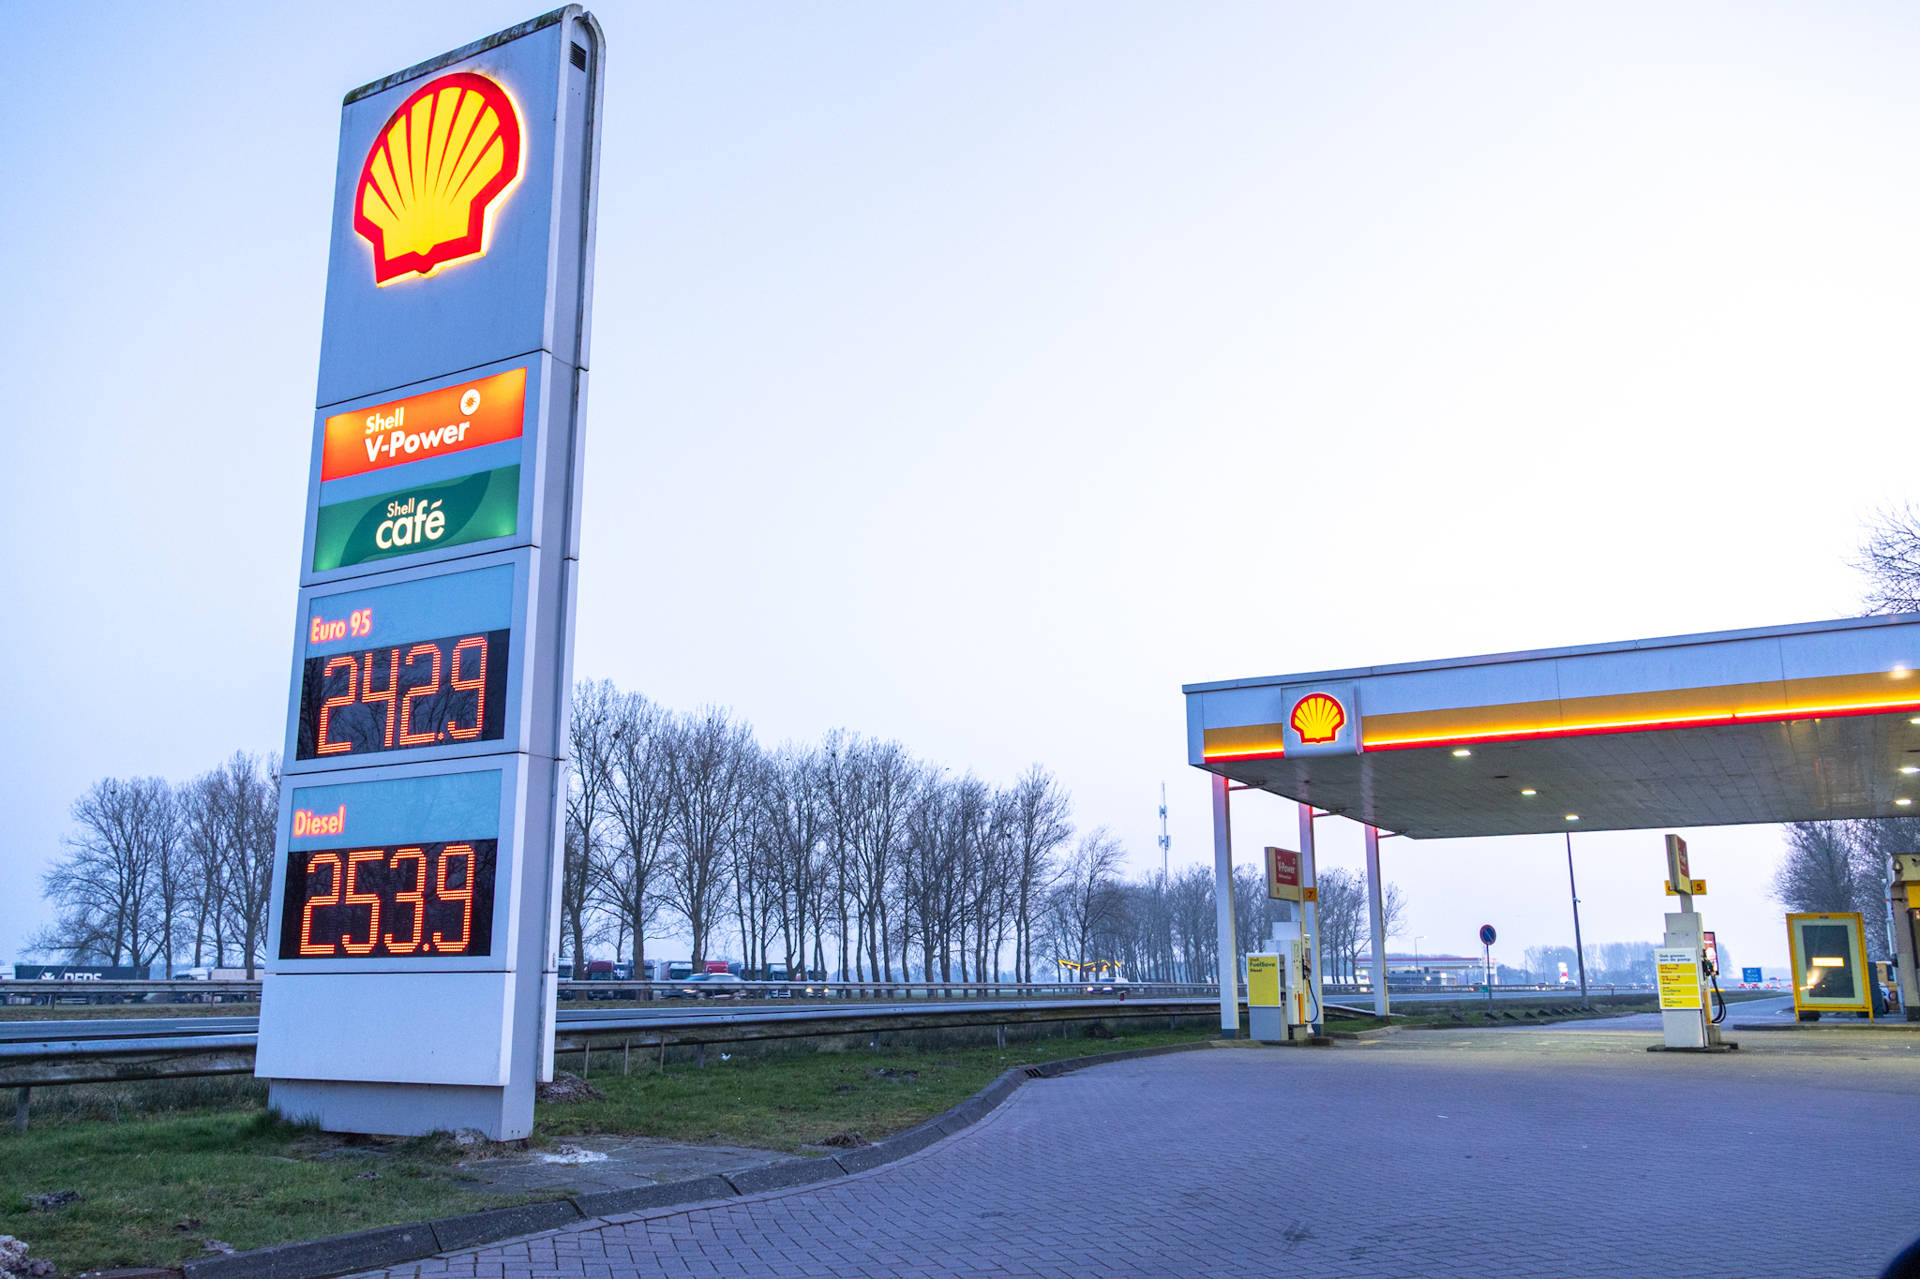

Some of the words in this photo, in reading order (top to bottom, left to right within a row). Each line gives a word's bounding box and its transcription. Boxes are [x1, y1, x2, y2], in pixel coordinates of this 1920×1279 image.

[365, 407, 405, 435] Shell
[364, 421, 471, 463] V-Power
[375, 499, 446, 550] café
[386, 497, 416, 518] Shell
[310, 617, 346, 643] Euro
[349, 609, 372, 637] 95
[317, 636, 488, 755] 242.9
[293, 805, 345, 837] Diesel
[300, 844, 476, 955] 253.9
